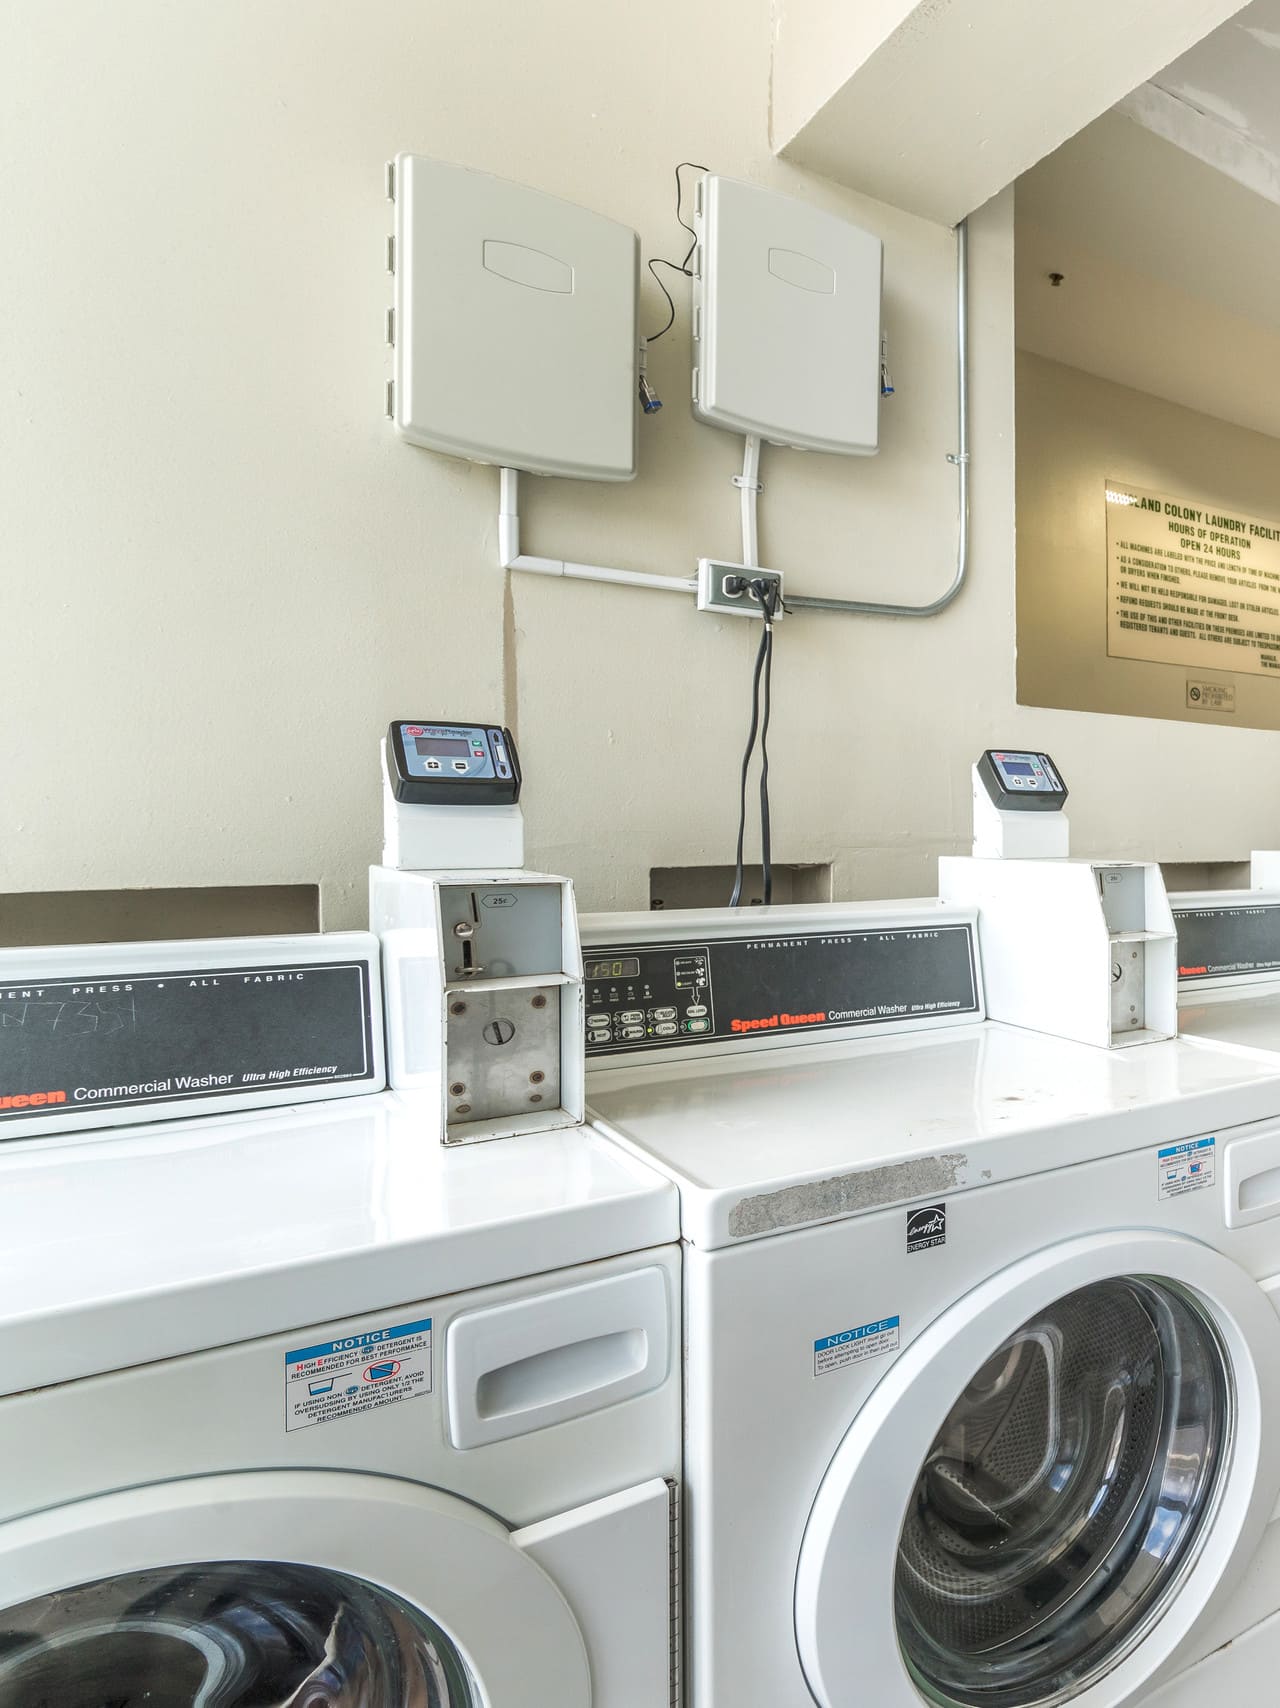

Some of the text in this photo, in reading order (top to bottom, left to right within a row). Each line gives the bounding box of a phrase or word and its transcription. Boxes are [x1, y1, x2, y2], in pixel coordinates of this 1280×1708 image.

[1124, 493, 1161, 513] LAND
[1165, 503, 1202, 523] COLONY
[1205, 513, 1246, 534] LAUNDRY
[1169, 521, 1251, 550] HOURS OF OPERATION
[1164, 549, 1183, 561] LABELED
[1181, 538, 1240, 561] OPEN 24 HOURS
[746, 940, 809, 950] PERMANENT
[1208, 964, 1236, 972] Commercial
[0, 974, 304, 999] ENT PRESS ALL FABRIC
[731, 1014, 778, 1032] Speed
[780, 1011, 826, 1026] Queen
[828, 1006, 876, 1020] Commercial
[878, 1004, 907, 1015] Washer
[924, 1002, 936, 1011] High
[937, 1000, 960, 1009] Efficiency
[74, 1079, 171, 1100] Commercial
[175, 1074, 234, 1089] Washer
[242, 1073, 266, 1082] Ultra
[269, 1070, 287, 1080] High
[293, 1066, 337, 1076] Efficiency
[1176, 1144, 1198, 1152] NOTICE
[908, 1237, 945, 1251] ENERGY STAR
[332, 1330, 390, 1351] NOTICE
[827, 1320, 888, 1346] NOTICE
[291, 1362, 344, 1379] RECOMMENDED
[346, 1358, 360, 1366] FOR
[361, 1353, 379, 1361] BEST
[380, 1341, 427, 1357] PERFORMANCE
[296, 1362, 316, 1371] HIGH
[317, 1351, 358, 1366] EFFICIENCY
[377, 1337, 415, 1351] DETERGENT
[817, 1349, 833, 1358] DOOR
[834, 1344, 850, 1352] LOCK
[851, 1339, 866, 1348] LIGHT
[817, 1356, 833, 1364] before
[834, 1348, 860, 1360] attempting
[295, 1398, 346, 1415] OVERSUDSING
[359, 1389, 380, 1397] USING
[303, 1397, 325, 1407] USING
[405, 1371, 424, 1379] AVOID
[308, 1403, 350, 1418] DETERGENT
[353, 1387, 412, 1406] MANUFACTURERS
[317, 1395, 402, 1422] RECOMMENDED AMOUNT
